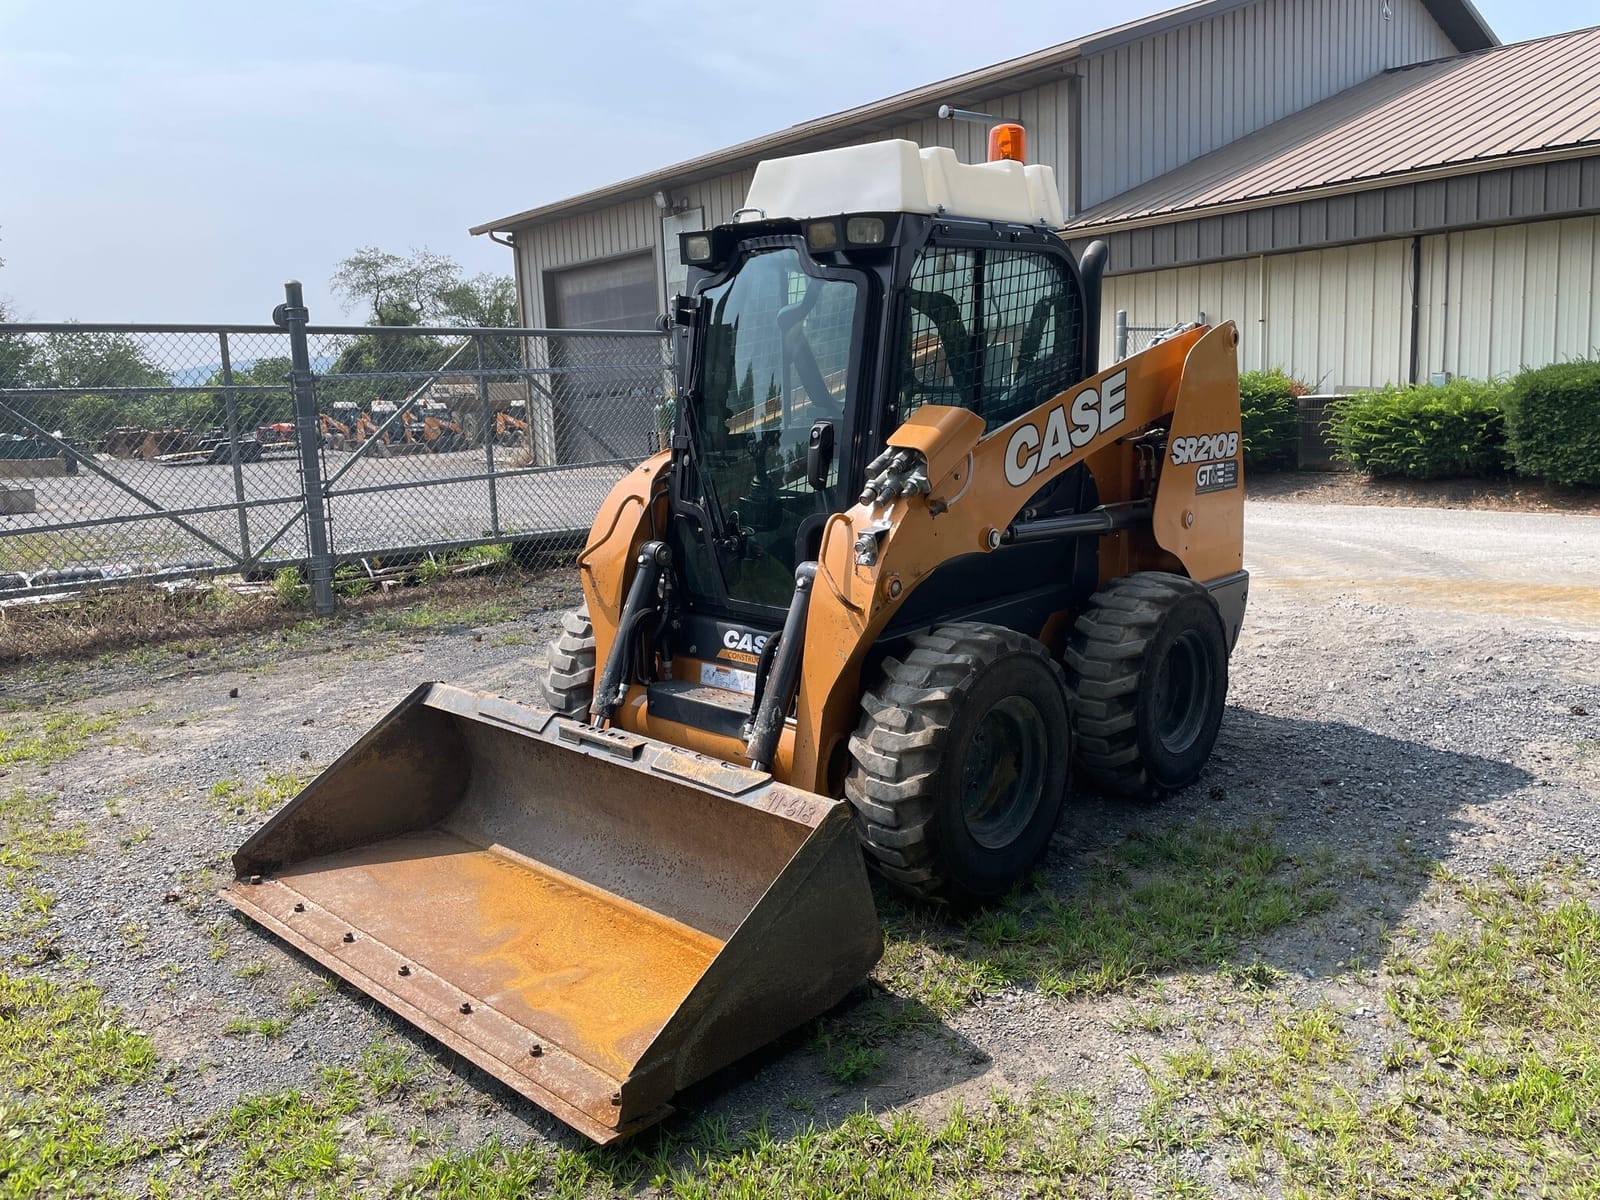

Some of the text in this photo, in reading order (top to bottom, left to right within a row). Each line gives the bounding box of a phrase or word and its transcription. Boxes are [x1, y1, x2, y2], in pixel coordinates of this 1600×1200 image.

[1004, 368, 1127, 487] CASE
[1171, 432, 1239, 465] SR210B
[723, 630, 770, 655] CAS
